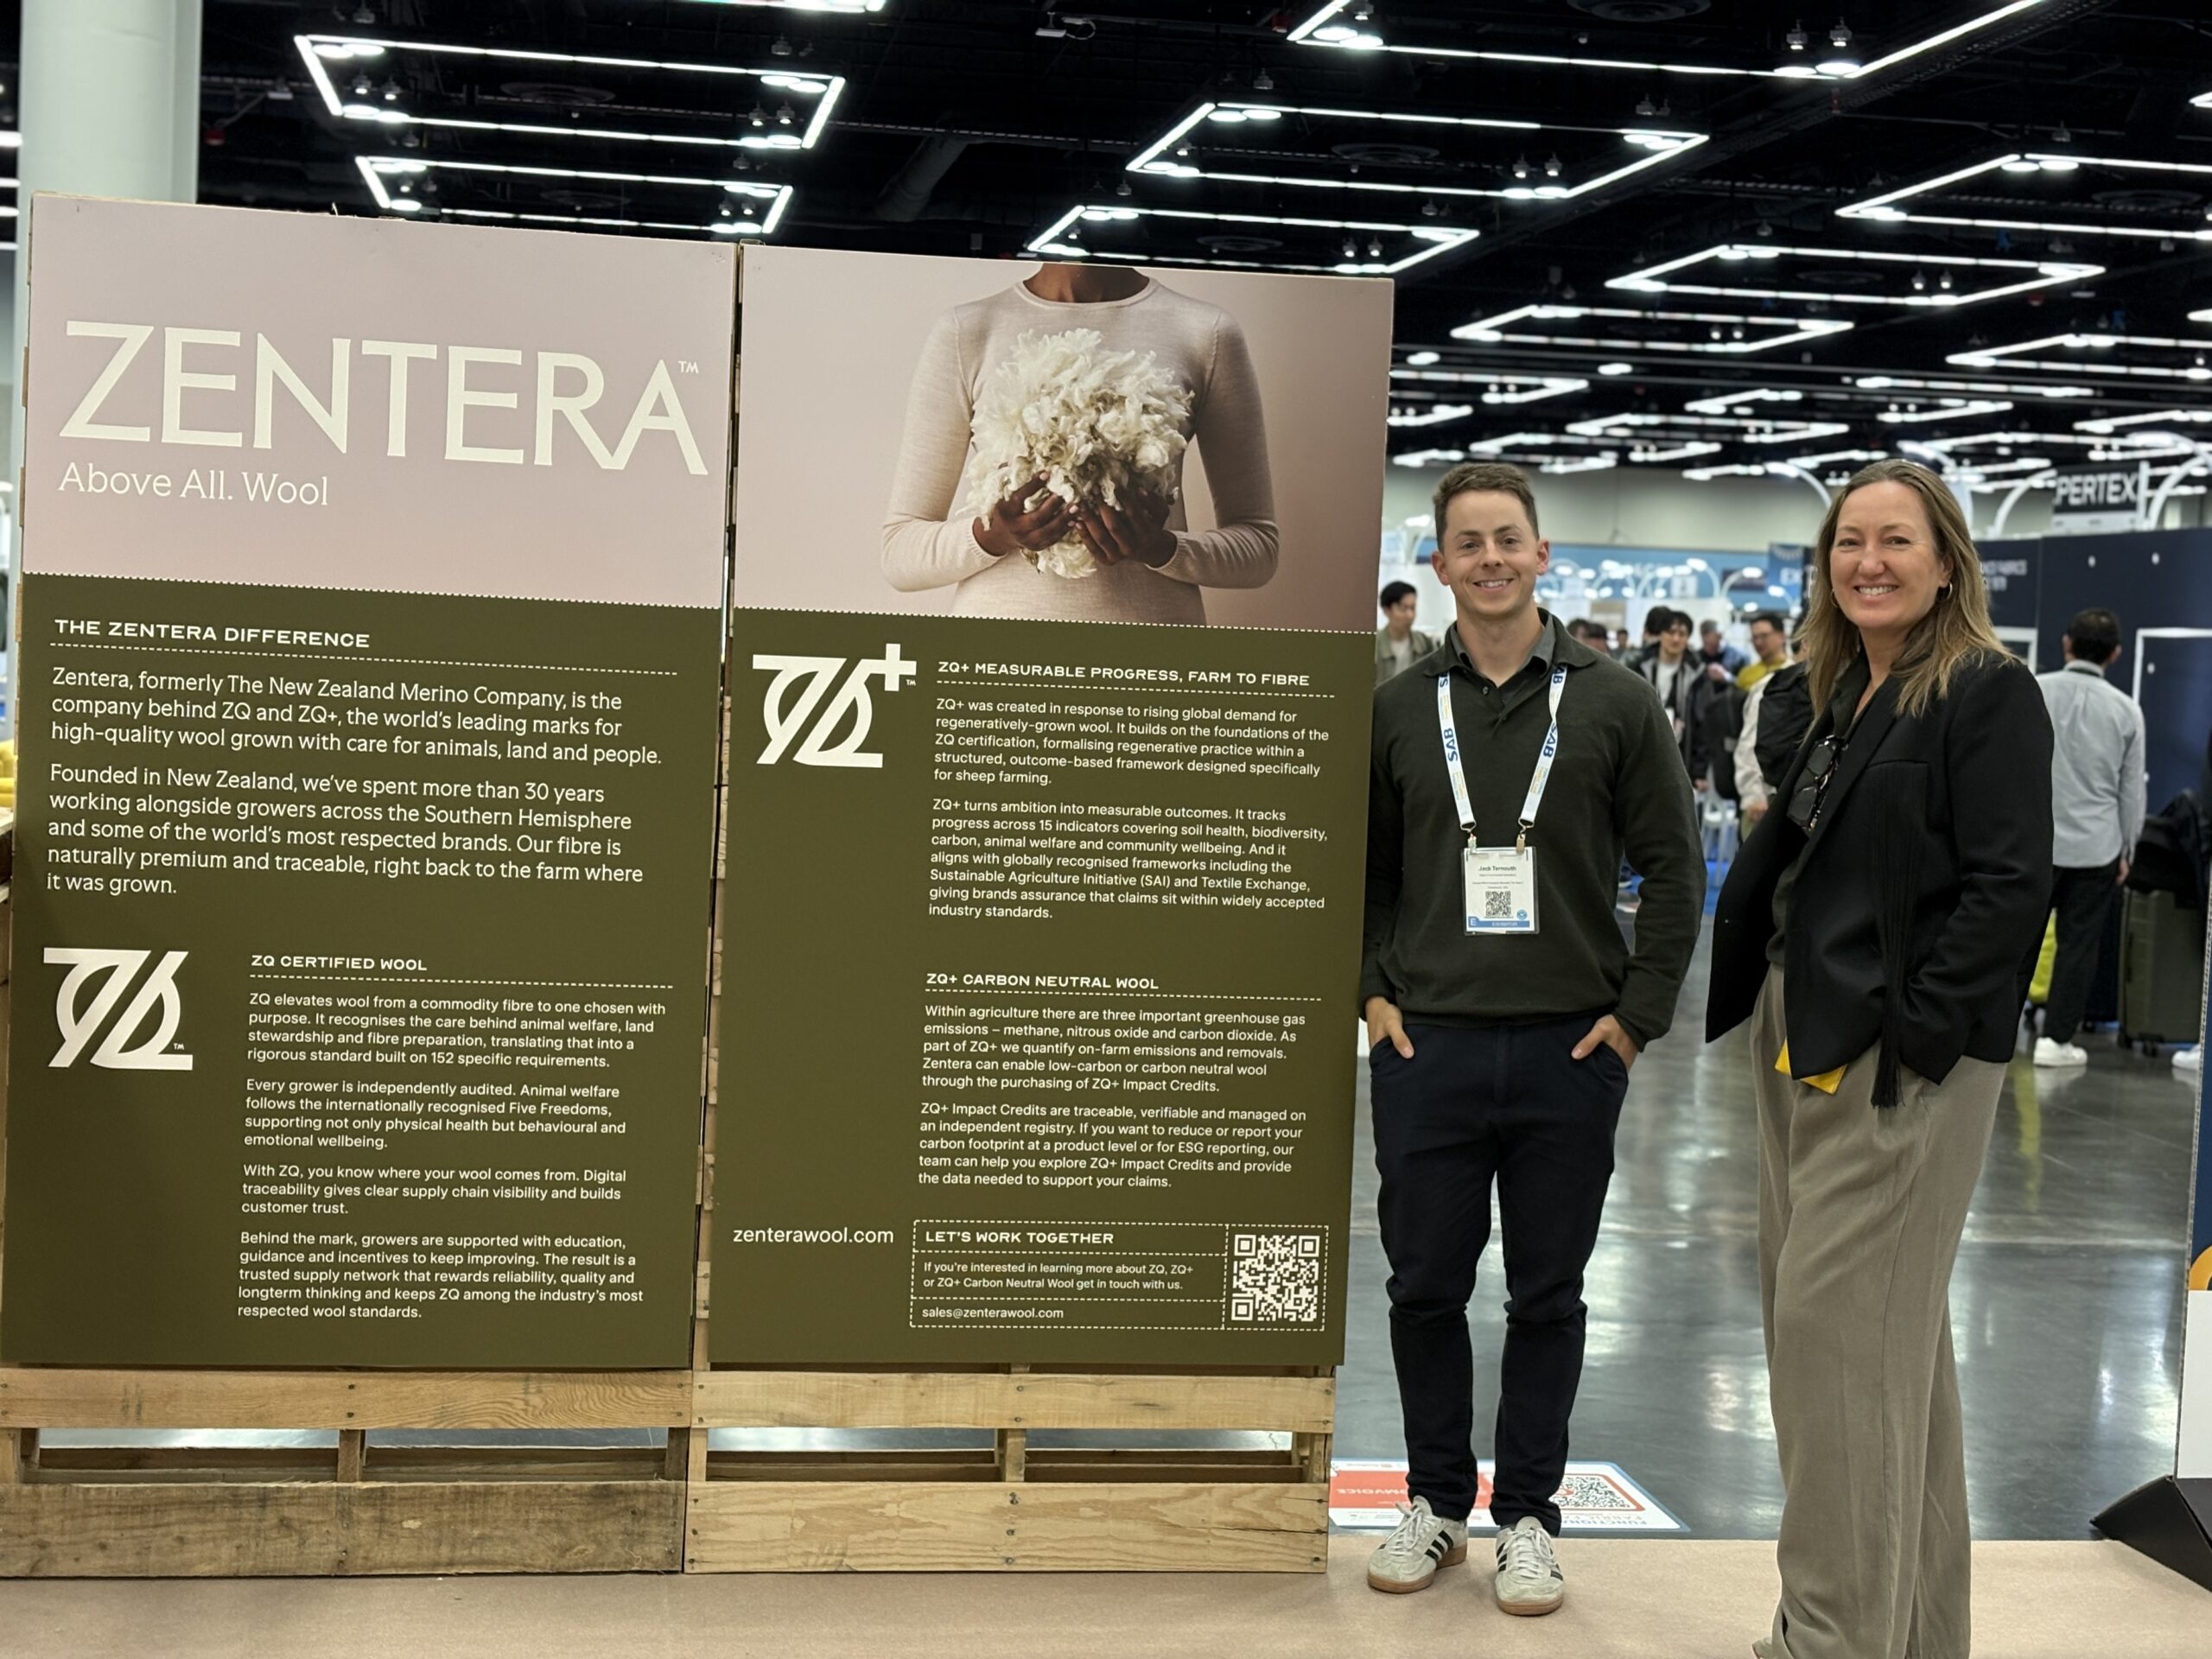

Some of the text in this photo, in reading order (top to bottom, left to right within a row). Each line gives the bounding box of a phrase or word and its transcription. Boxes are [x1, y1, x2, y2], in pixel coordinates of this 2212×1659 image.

[60, 321, 709, 475] ZENTERA
[58, 462, 327, 505] Above All. Wool
[2053, 474, 2139, 505] PERTEX
[54, 620, 370, 648] THE ZENTERA DIFFERENCE
[938, 661, 1309, 686] ZQ+ MEASURABLE PROGRESS, FARM TO FIBRE
[1553, 664, 1566, 684] AB
[53, 667, 622, 711] Zentera, formerly The New Zealand Merino Company, is the
[52, 698, 622, 736] company behind ZQ and ZQ+, the world's leading marks for
[935, 734, 1305, 757] ZQ certification, formalising regenerative practice within a
[1444, 728, 1458, 762] SAB
[1543, 722, 1557, 758] SAB
[935, 752, 1320, 778] structured, outcome-based framework designed specifically
[51, 764, 604, 804] Founded in New Zealand, we've spent more than 30 years
[49, 791, 632, 832] working alongside growers across the Southern Hemisphere
[931, 868, 1310, 893] Sustainable Agriculture Initiative (SAI) and Textile Exchange,
[929, 904, 1052, 918] industry standards.
[1470, 918, 1477, 926] E
[251, 955, 427, 970] ZQ CERTIFIED WOOL
[926, 973, 1159, 989] ZQ+ CARBON NEUTRAL WOOL
[248, 1030, 634, 1051] stewardship and fibre preparation, translating that into a
[923, 1058, 1267, 1075] Zentera can enable low-carbon or carbon neutral wool
[245, 1096, 612, 1117] follows the internationally recognised Five Freedoms,
[245, 1134, 387, 1150] emotional wellbeing.
[243, 1183, 620, 1201] traceability gives clear supply chain visibility and builds
[241, 1231, 626, 1249] Behind the mark, growers are supported with education,
[734, 1227, 893, 1243] zenterawool.com
[926, 1231, 1114, 1243] LET'S WORK TOGETHER
[925, 1262, 1193, 1275] If you're interested in learning more about ZQ, ZQ+
[238, 1305, 422, 1319] respected wool standards.
[922, 1306, 1064, 1319] sales@zenterawool.com
